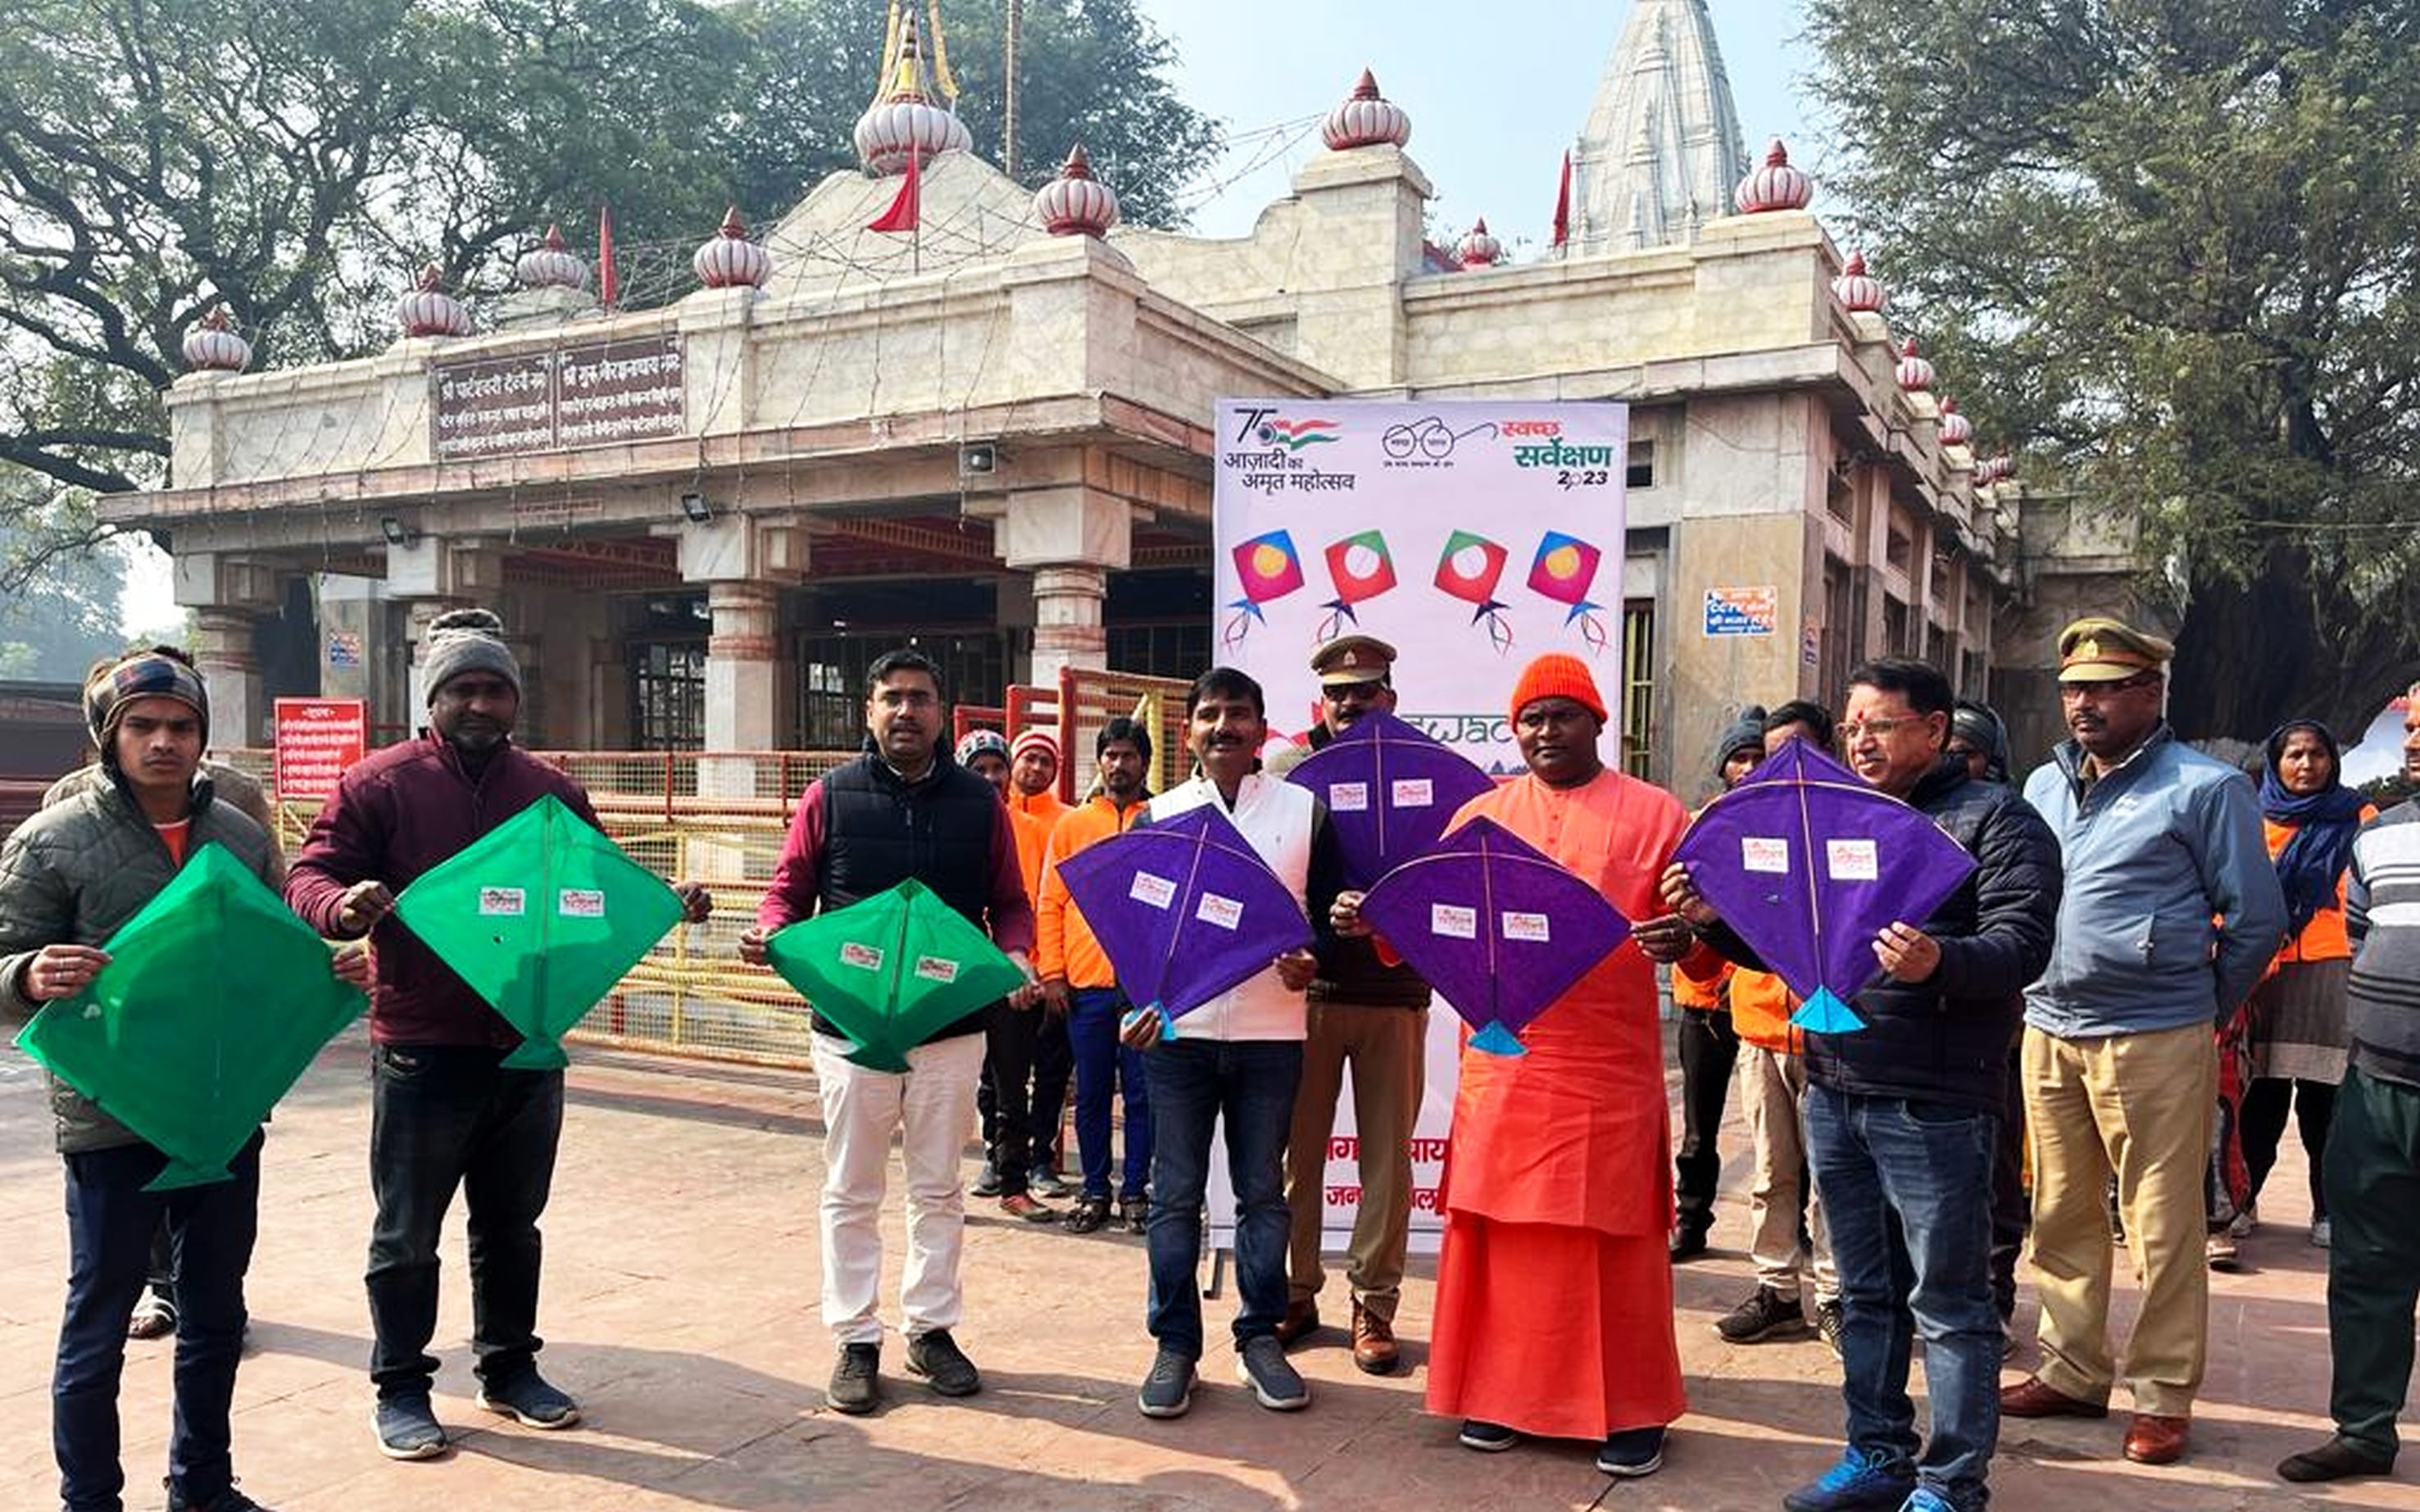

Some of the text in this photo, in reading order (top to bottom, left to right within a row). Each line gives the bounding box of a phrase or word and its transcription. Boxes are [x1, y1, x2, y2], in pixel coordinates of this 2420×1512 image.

[1224, 448, 1287, 470] आज़ादी
[1514, 436, 1614, 467] सर्वेक्षण
[1242, 469, 1355, 496] अमृत महोत्सव
[1557, 470, 1608, 491] 2023
